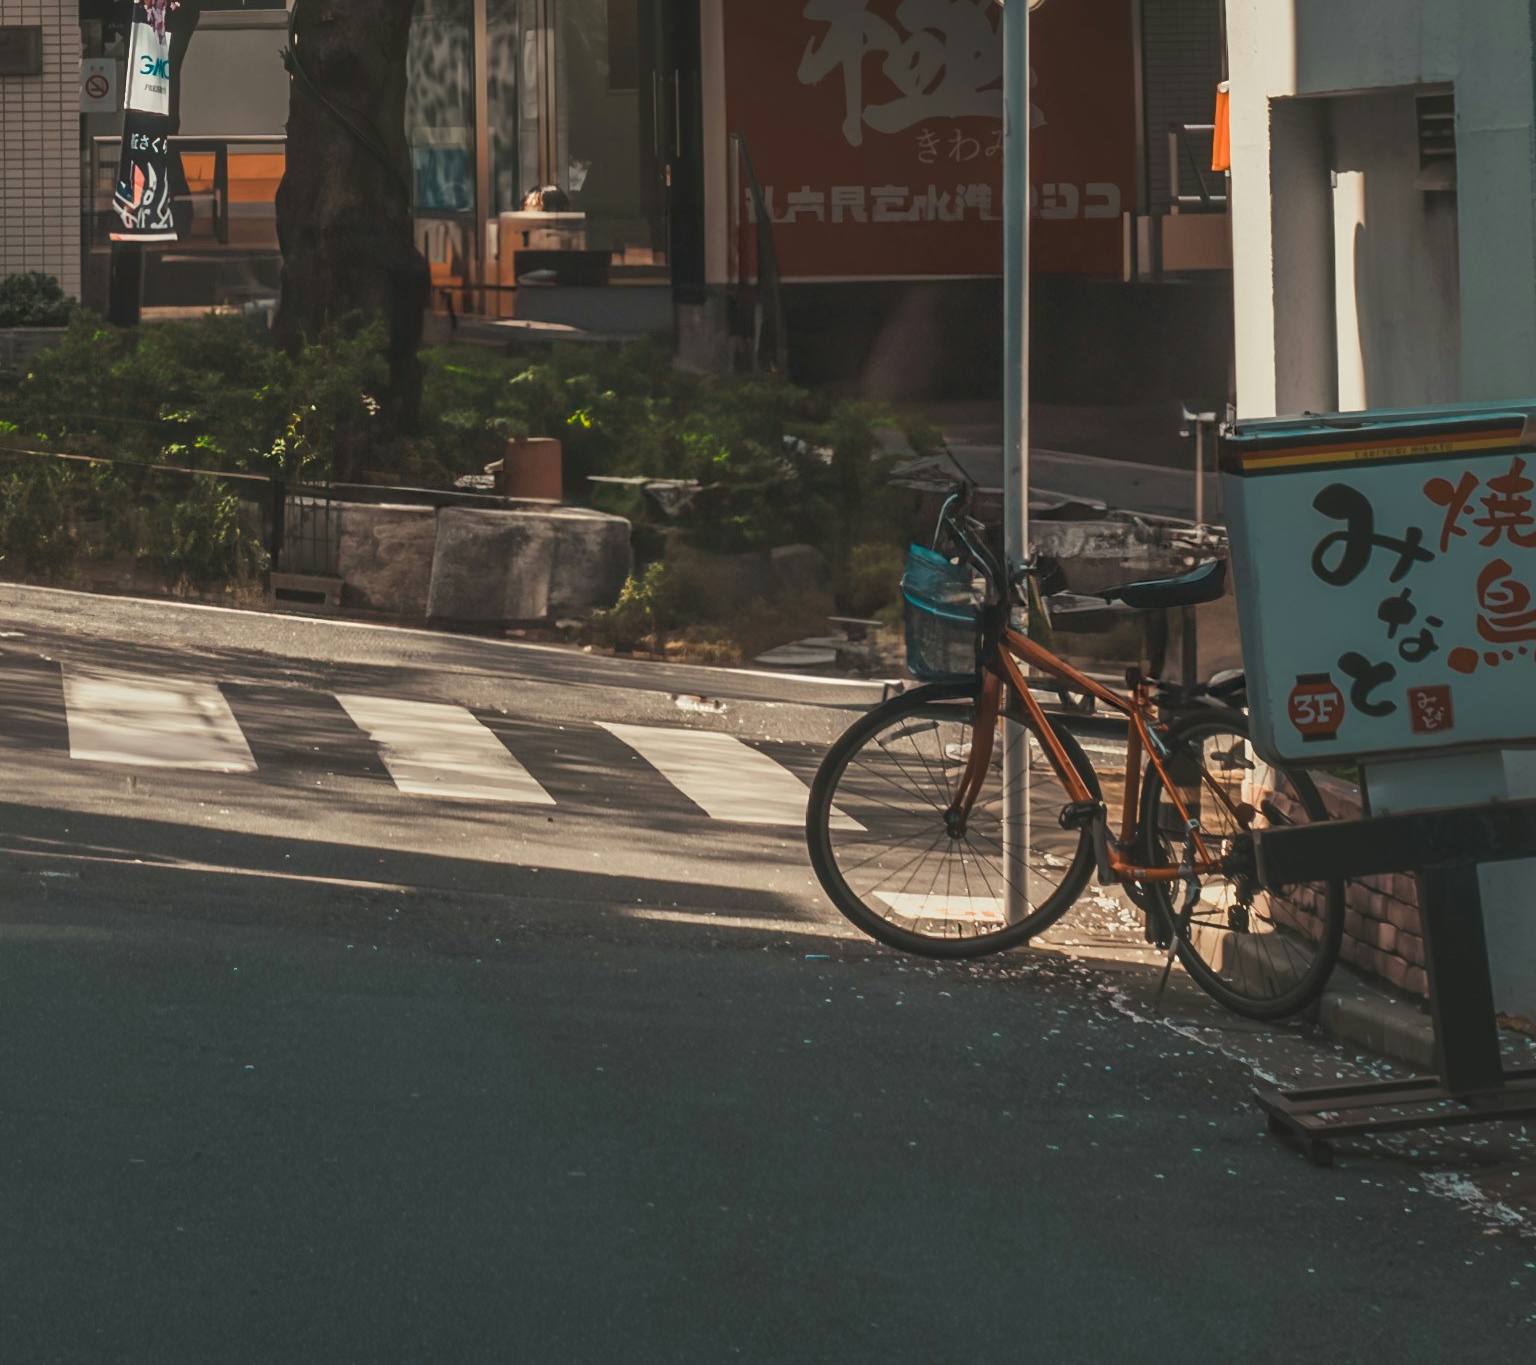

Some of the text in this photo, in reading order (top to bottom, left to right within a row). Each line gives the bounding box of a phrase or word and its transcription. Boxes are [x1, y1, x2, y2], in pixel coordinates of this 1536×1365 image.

[1310, 482, 1445, 717] みなと
[1293, 692, 1338, 725] 3F
